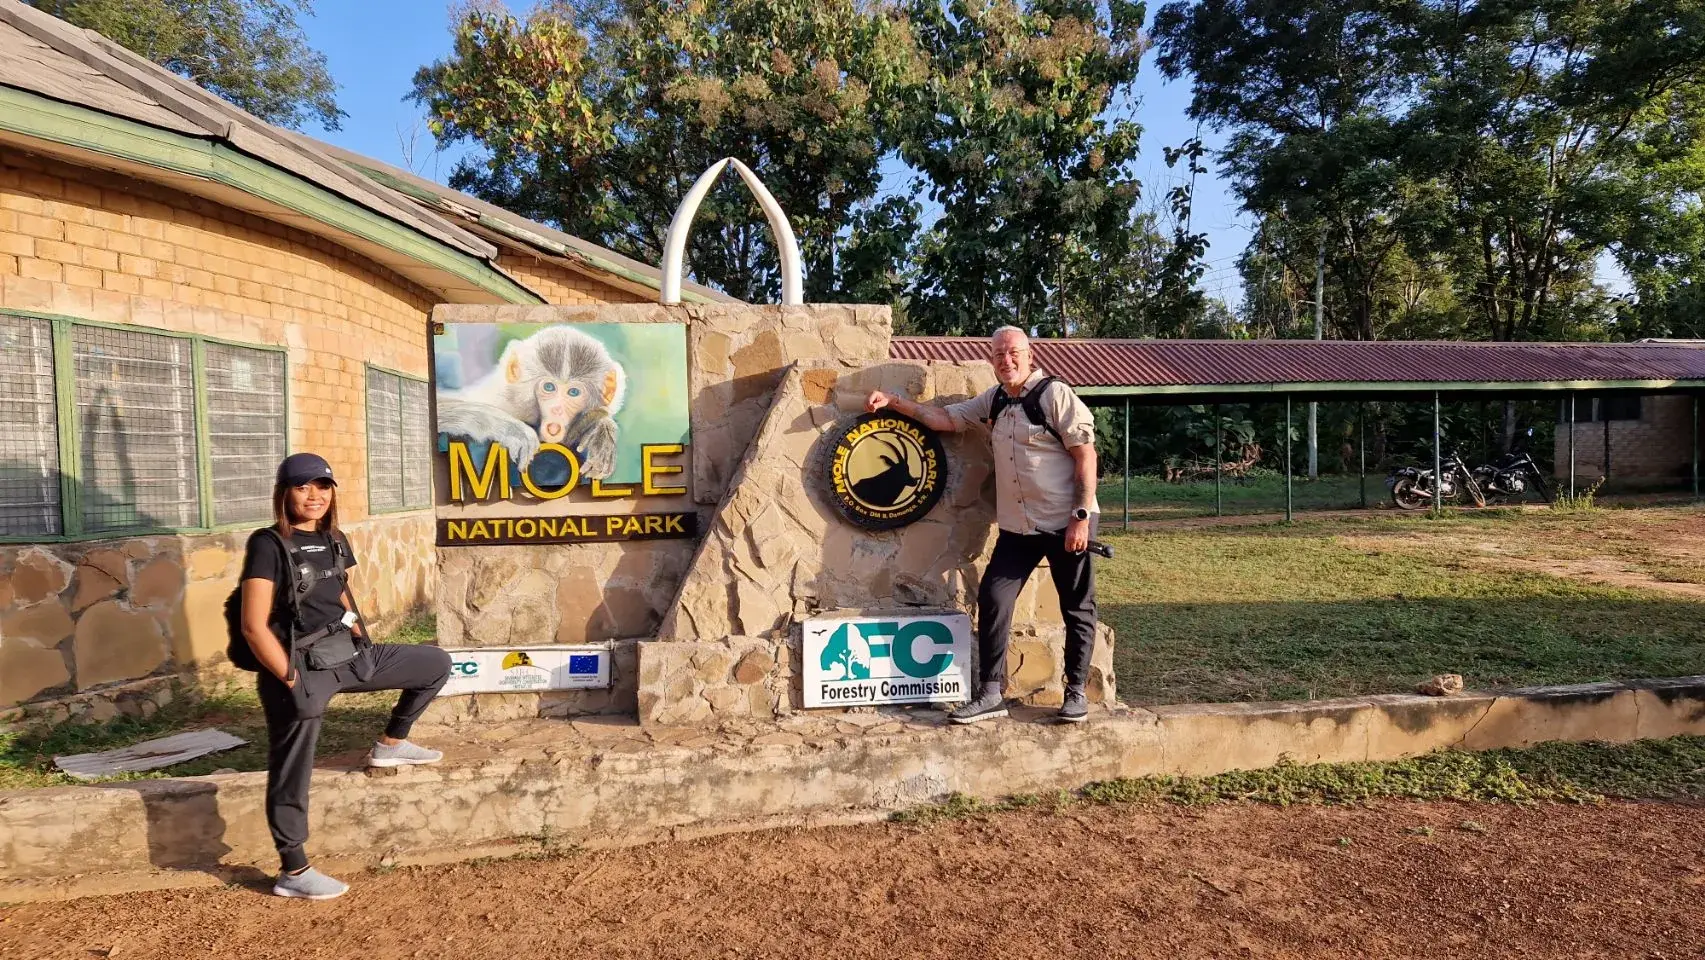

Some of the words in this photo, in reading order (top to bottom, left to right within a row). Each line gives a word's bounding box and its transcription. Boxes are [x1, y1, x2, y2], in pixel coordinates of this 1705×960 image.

[449, 441, 687, 500] MOLE
[832, 444, 848, 493] MOLE
[846, 418, 926, 446] NATIONAL
[924, 448, 937, 492] PARK
[447, 518, 598, 541] NATIONAL
[606, 514, 686, 536] PARK
[820, 682, 877, 702] Forestry
[880, 679, 960, 697] Commission
